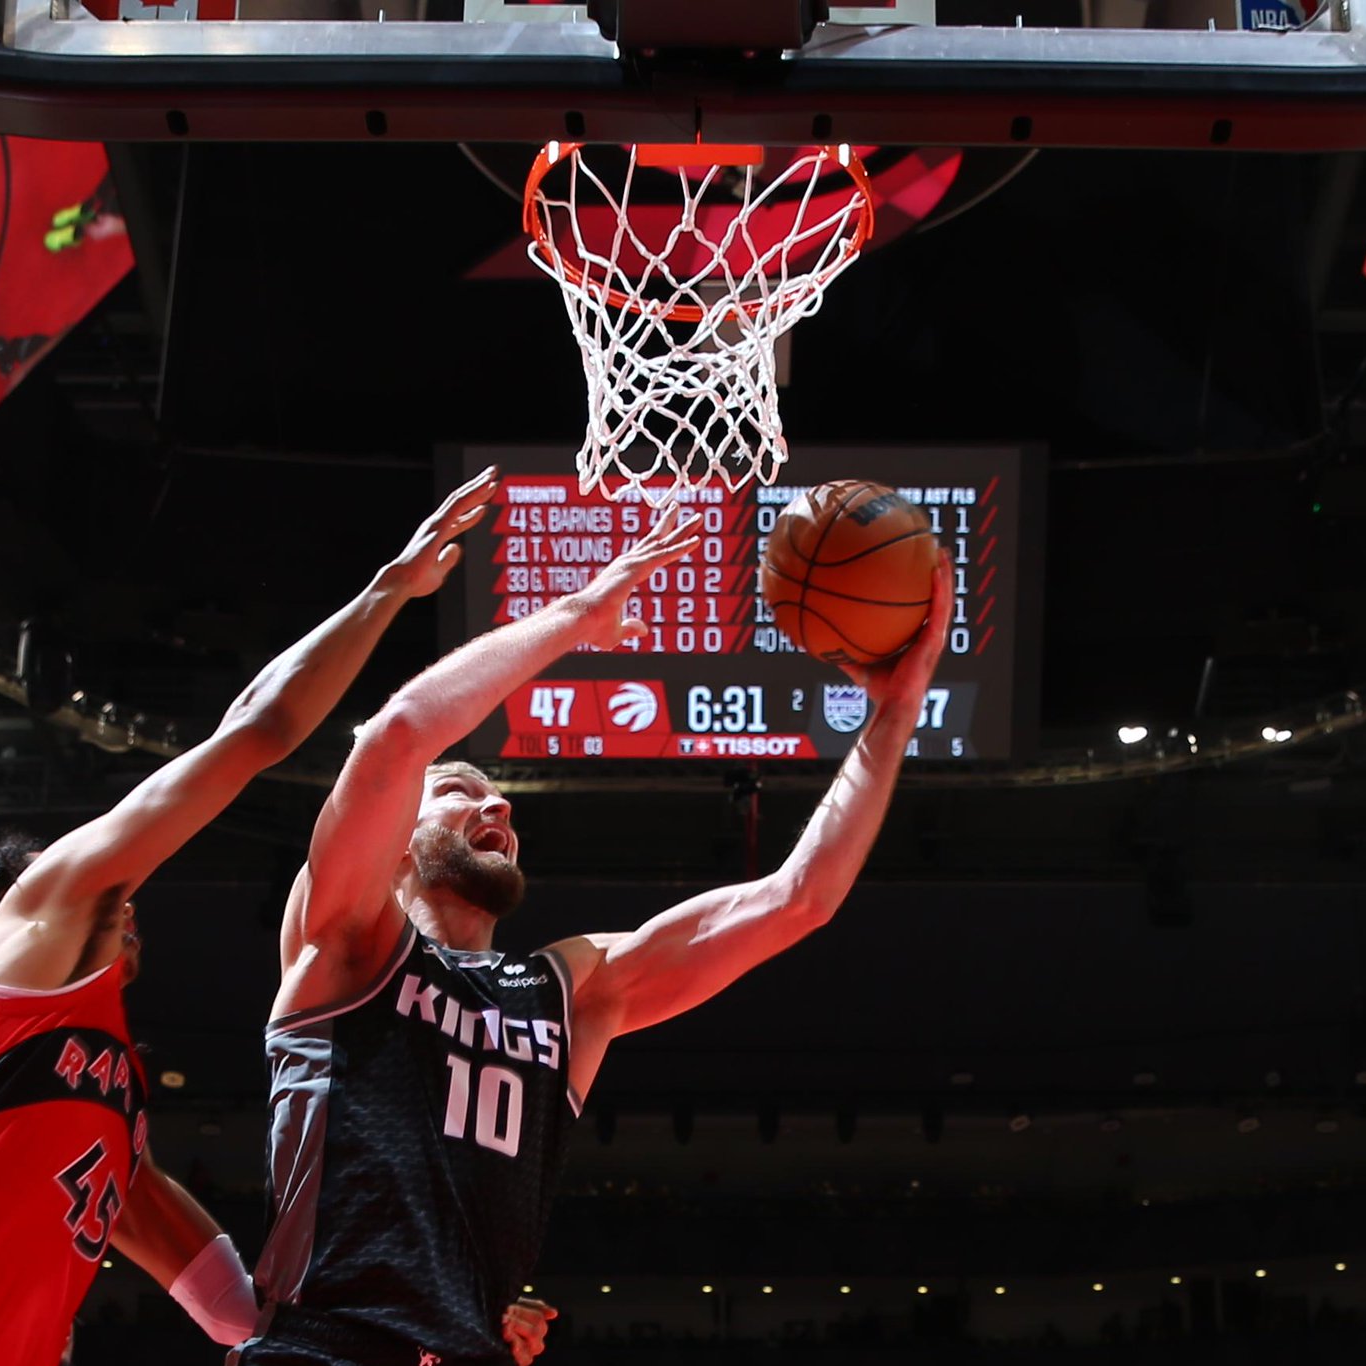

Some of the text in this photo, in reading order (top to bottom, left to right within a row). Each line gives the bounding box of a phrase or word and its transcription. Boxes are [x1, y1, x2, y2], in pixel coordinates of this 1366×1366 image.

[509, 507, 526, 533] 4
[549, 507, 613, 533] BARNES
[621, 507, 640, 533] 5
[704, 507, 723, 533] 0
[757, 506, 776, 533] 0
[955, 507, 970, 533] 1
[507, 537, 528, 563] 21
[550, 537, 613, 563] YOUNG
[704, 537, 722, 563] 0
[955, 537, 969, 563] 1
[507, 566, 529, 592] 33
[649, 566, 668, 592] 0
[677, 566, 695, 592] 0
[704, 566, 722, 592] 2
[954, 568, 968, 594] 1
[651, 596, 665, 623] 1
[677, 596, 695, 623] 2
[705, 596, 720, 623] 1
[953, 598, 967, 624] 1
[651, 626, 665, 652] 1
[677, 626, 695, 652] 0
[704, 626, 722, 652] 0
[950, 627, 970, 653] 0
[529, 687, 575, 727] 47
[688, 685, 767, 732] 6:31
[792, 688, 804, 711] 2
[548, 736, 560, 755] 5
[713, 738, 800, 755] TISSOT
[952, 737, 964, 756] 5
[396, 974, 561, 1070] KINGS
[444, 1054, 523, 1158] 10
[55, 1136, 123, 1263] 45
